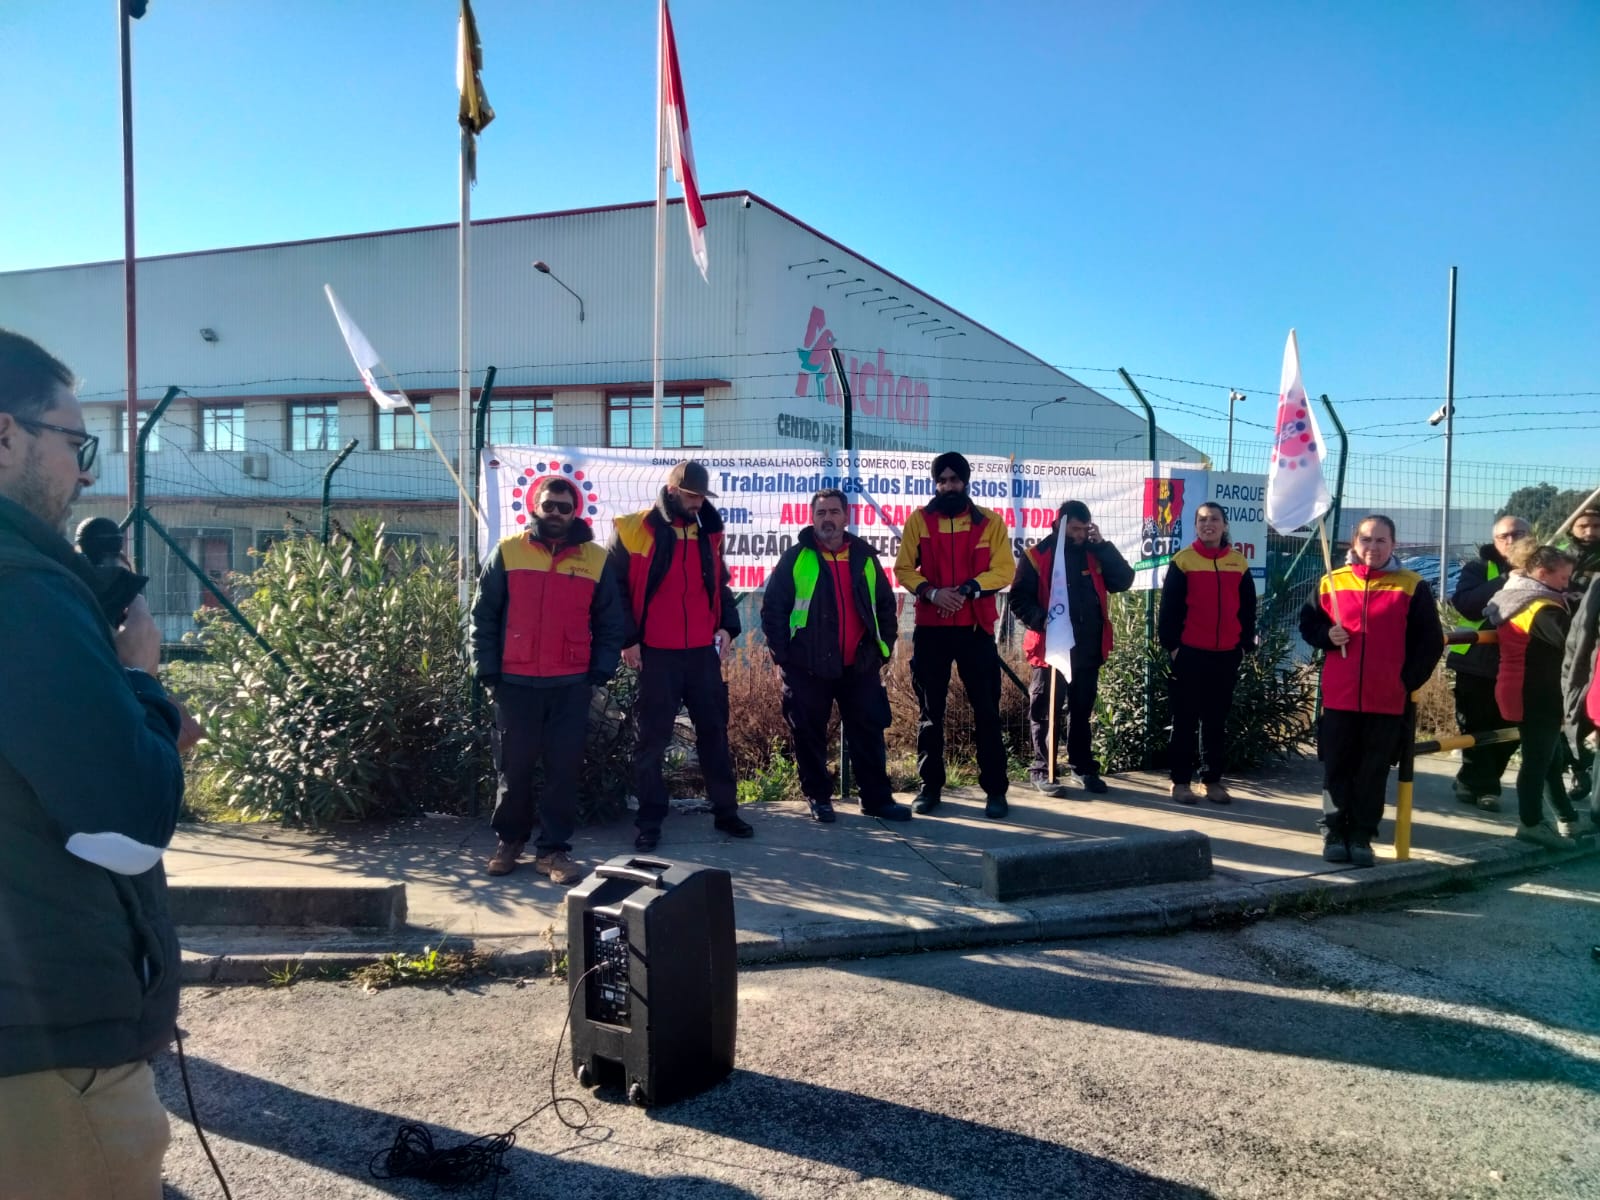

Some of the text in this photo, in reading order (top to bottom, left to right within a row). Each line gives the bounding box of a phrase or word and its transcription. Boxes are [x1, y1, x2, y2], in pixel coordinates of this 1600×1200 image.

[795, 306, 930, 431] Auchan
[777, 412, 820, 443] CENTRO
[823, 423, 836, 446] DE
[712, 458, 736, 468] DOS
[739, 458, 833, 468] TRABALHADORES
[836, 458, 851, 468] DO
[977, 462, 985, 472] E
[986, 462, 1031, 476] SERVIÇOS
[1033, 465, 1046, 476] DE
[1047, 466, 1097, 477] PORTUGAL
[719, 472, 865, 494] Trabalhadores
[867, 474, 901, 496] dos
[1011, 478, 1042, 499] DHL
[1215, 484, 1265, 502] PARQUE
[1222, 506, 1265, 522] RIVADO
[1141, 537, 1181, 556] CGTP
[729, 566, 765, 588] FIM
